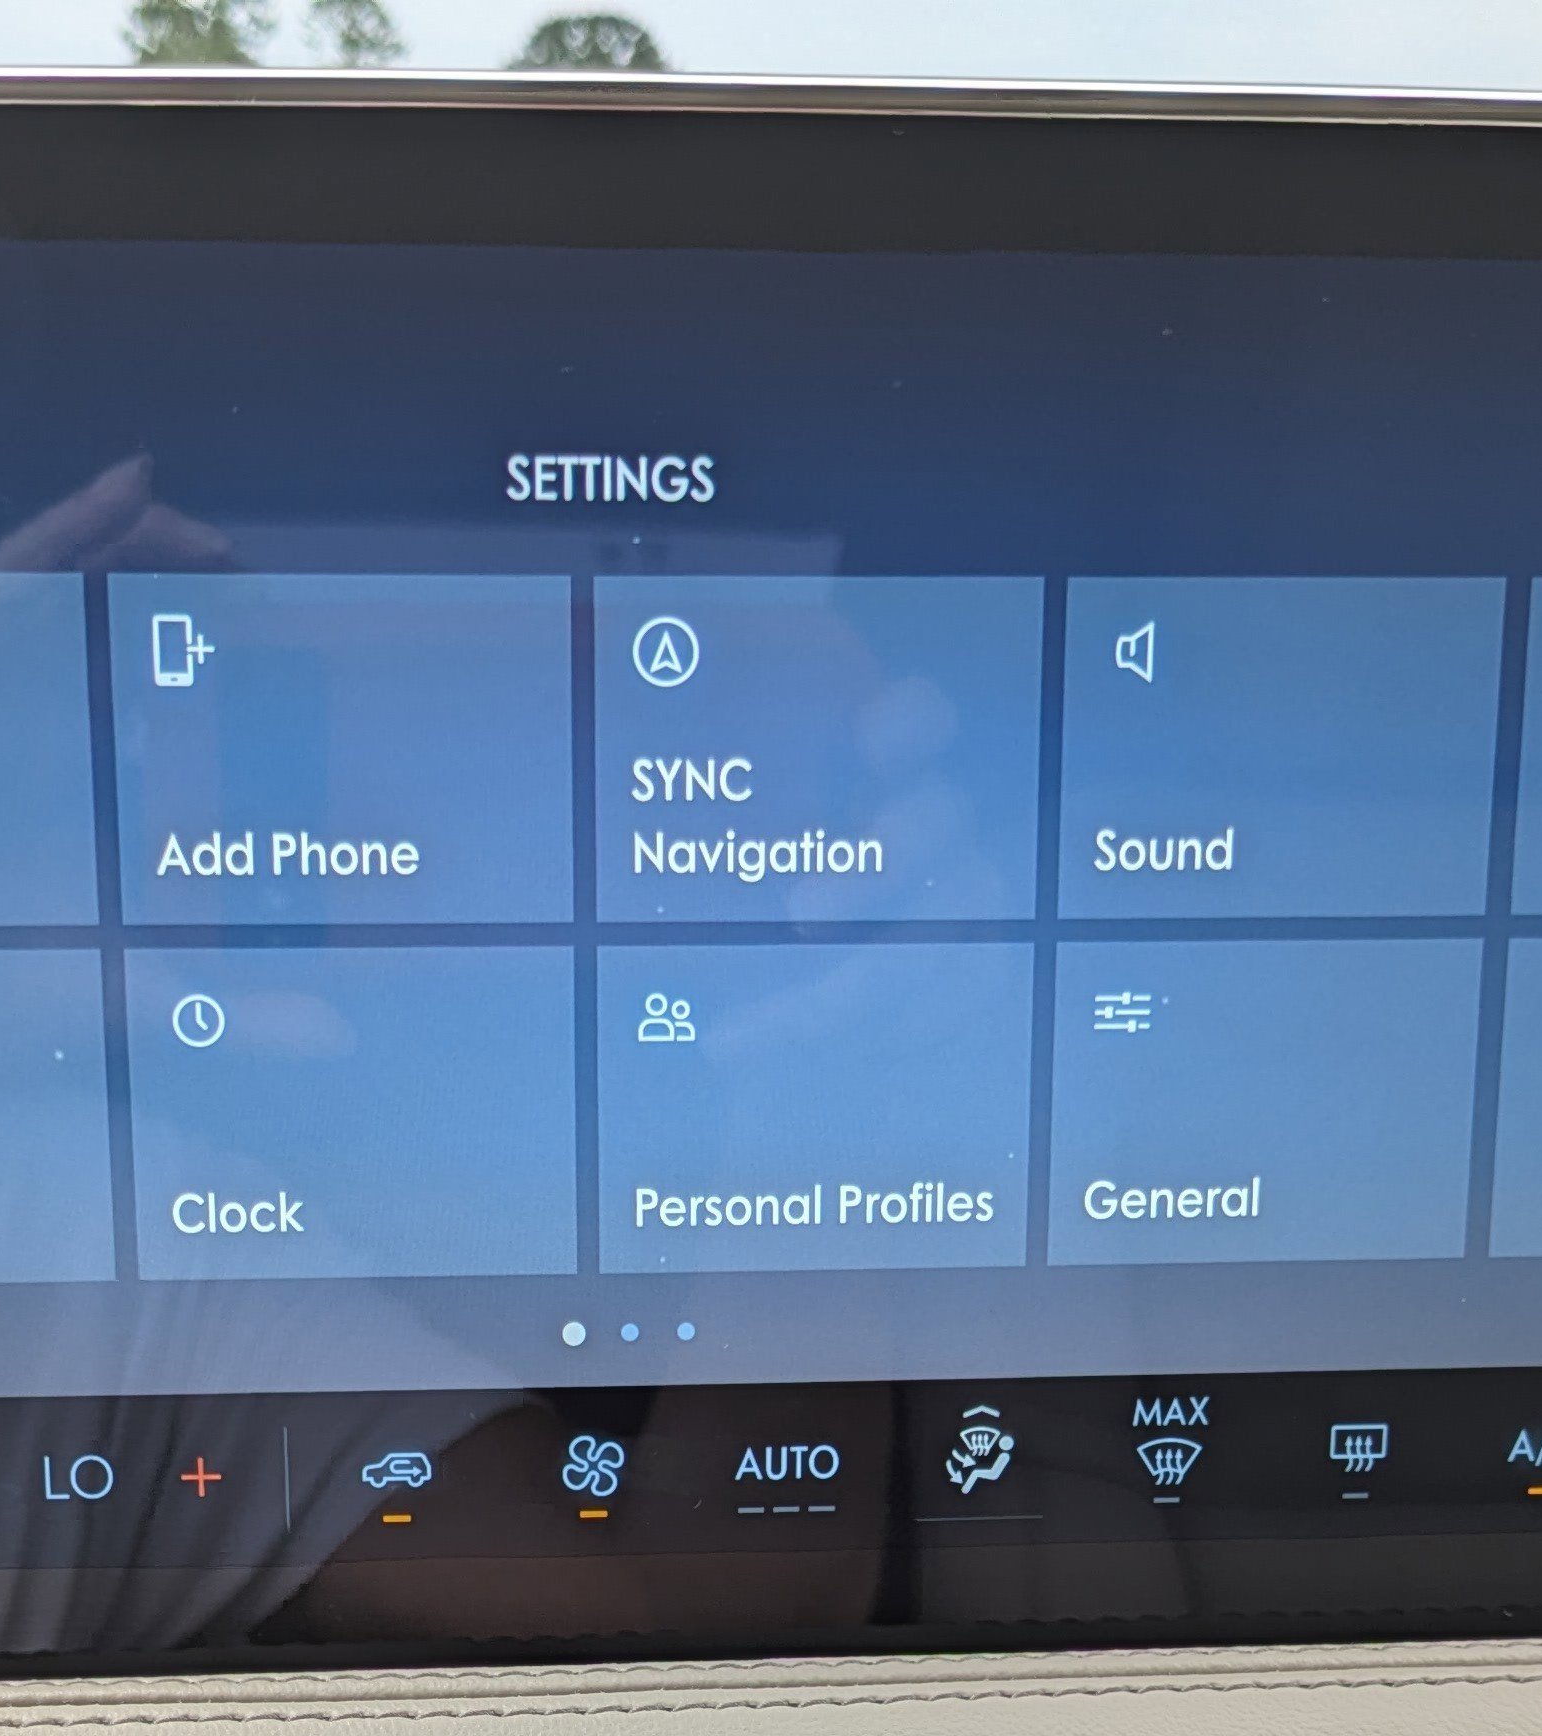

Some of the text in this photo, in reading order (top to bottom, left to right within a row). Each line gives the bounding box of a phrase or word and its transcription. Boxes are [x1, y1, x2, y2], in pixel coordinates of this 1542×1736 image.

[505, 453, 716, 504] SETTINGS
[630, 755, 754, 803] SYNC
[155, 829, 421, 877] Add Phone
[632, 827, 884, 884] Navigation
[1092, 826, 1236, 872] Sound
[171, 1190, 306, 1235] Clock
[635, 1180, 995, 1229] Personal Profiles
[1083, 1175, 1262, 1221] General
[1131, 1395, 1211, 1428] MAX
[43, 1453, 115, 1501] LO
[734, 1443, 841, 1482] AUTO
